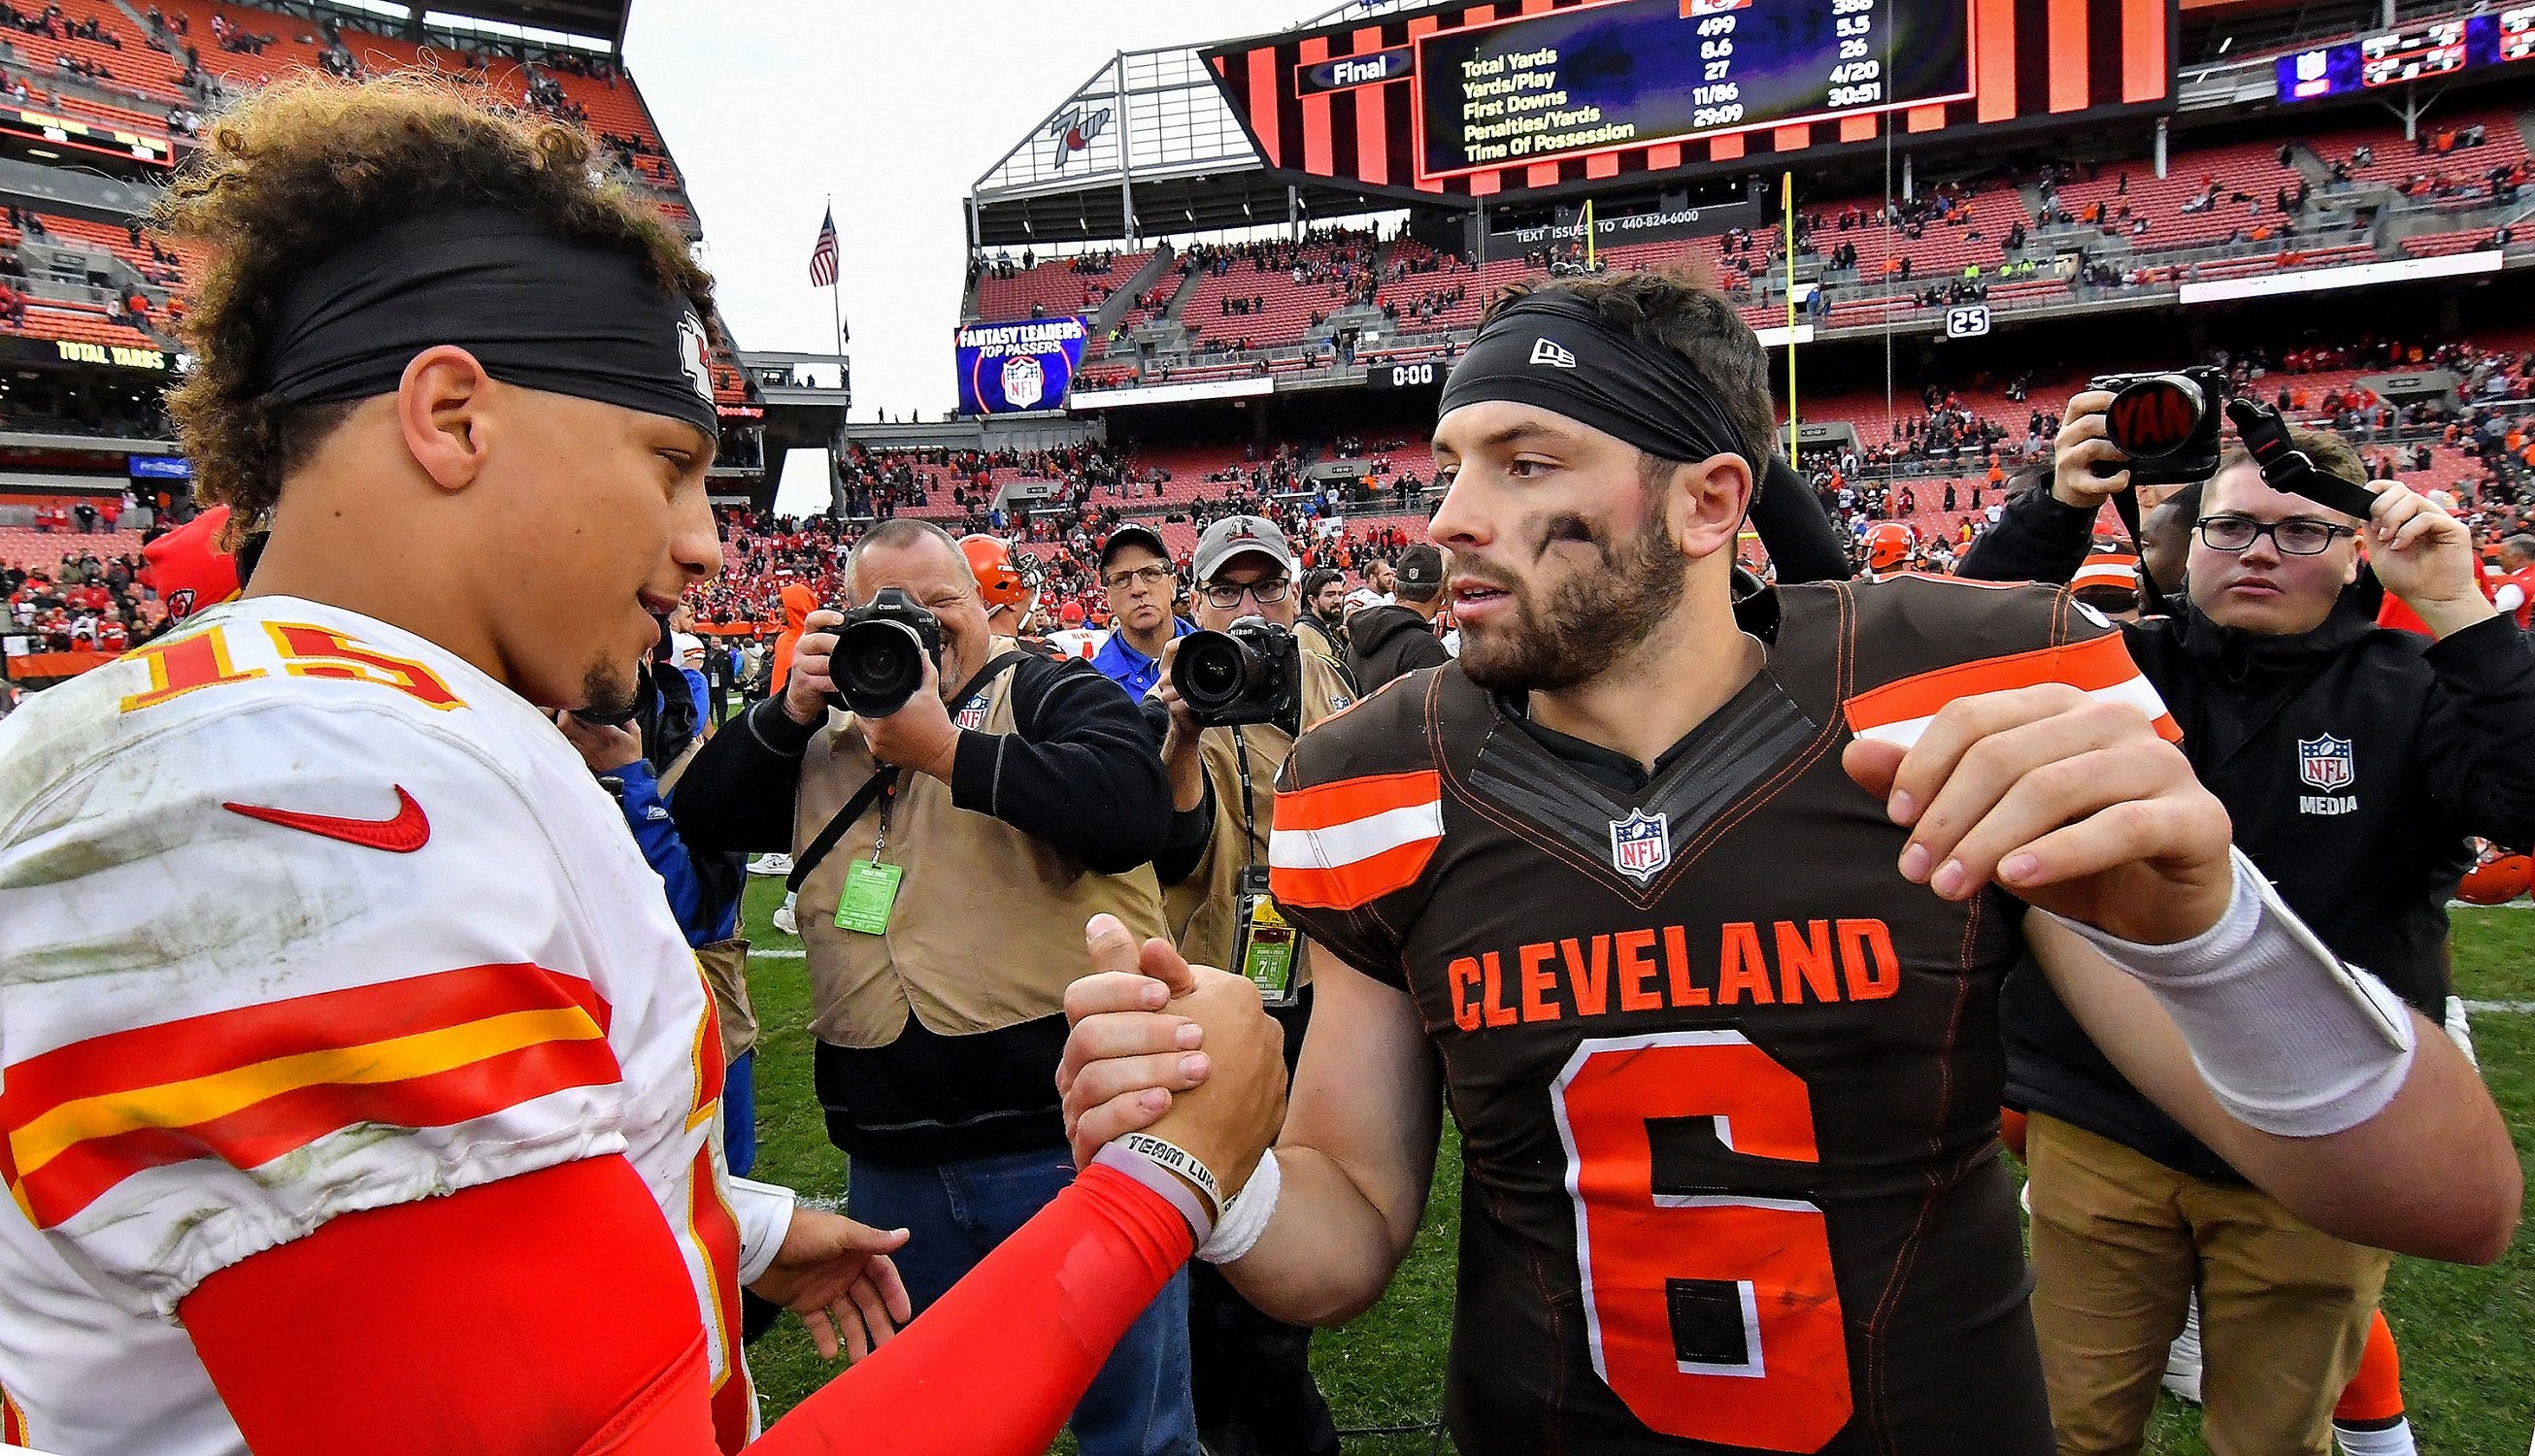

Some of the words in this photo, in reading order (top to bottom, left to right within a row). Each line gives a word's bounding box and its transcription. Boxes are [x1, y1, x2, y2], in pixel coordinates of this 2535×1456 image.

[1461, 54, 1505, 78] Total
[1507, 47, 1557, 71] Yards
[1696, 15, 1736, 37] 499
[1462, 71, 1557, 99] Yards/Play
[1700, 38, 1733, 59] 8.6
[1836, 15, 1871, 37] 5.5
[1333, 54, 1386, 85] Final
[1463, 99, 1505, 120] First
[1507, 90, 1568, 114] Downs
[1704, 60, 1730, 81] 27
[1839, 38, 1868, 59] 26
[1464, 105, 1601, 143] Penalties/Yards
[1692, 82, 1740, 106] 11/86
[1828, 60, 1880, 83] 4/20
[1464, 143, 1508, 162] Time
[1510, 136, 1532, 155] Of
[1534, 122, 1636, 152] Possession
[1693, 103, 1744, 127] 29:09
[1827, 82, 1882, 107] 30:51
[1517, 229, 1546, 243] TEXT
[1551, 224, 1589, 239] ISSUES
[1598, 221, 1615, 233] TO
[1621, 211, 1699, 229] 440-824-6000
[959, 325, 1019, 348] FANTASY
[1019, 321, 1083, 343] LEADERS
[1952, 310, 1985, 333] 25
[56, 340, 111, 364] TOTAL
[111, 347, 165, 371] YARDS
[980, 345, 1004, 359] TOP
[1005, 341, 1062, 357] PASSERS
[1011, 379, 1037, 399] NFL
[1392, 363, 1433, 386] 0:00
[120, 620, 473, 713] 15
[2307, 759, 2348, 783] NFL
[2299, 795, 2358, 815] MEDIA
[1621, 840, 1661, 868] NFL
[1448, 918, 1900, 1032] CLEVELAND
[1128, 1136, 1184, 1167] TEAM
[1551, 1029, 1854, 1455] 6
